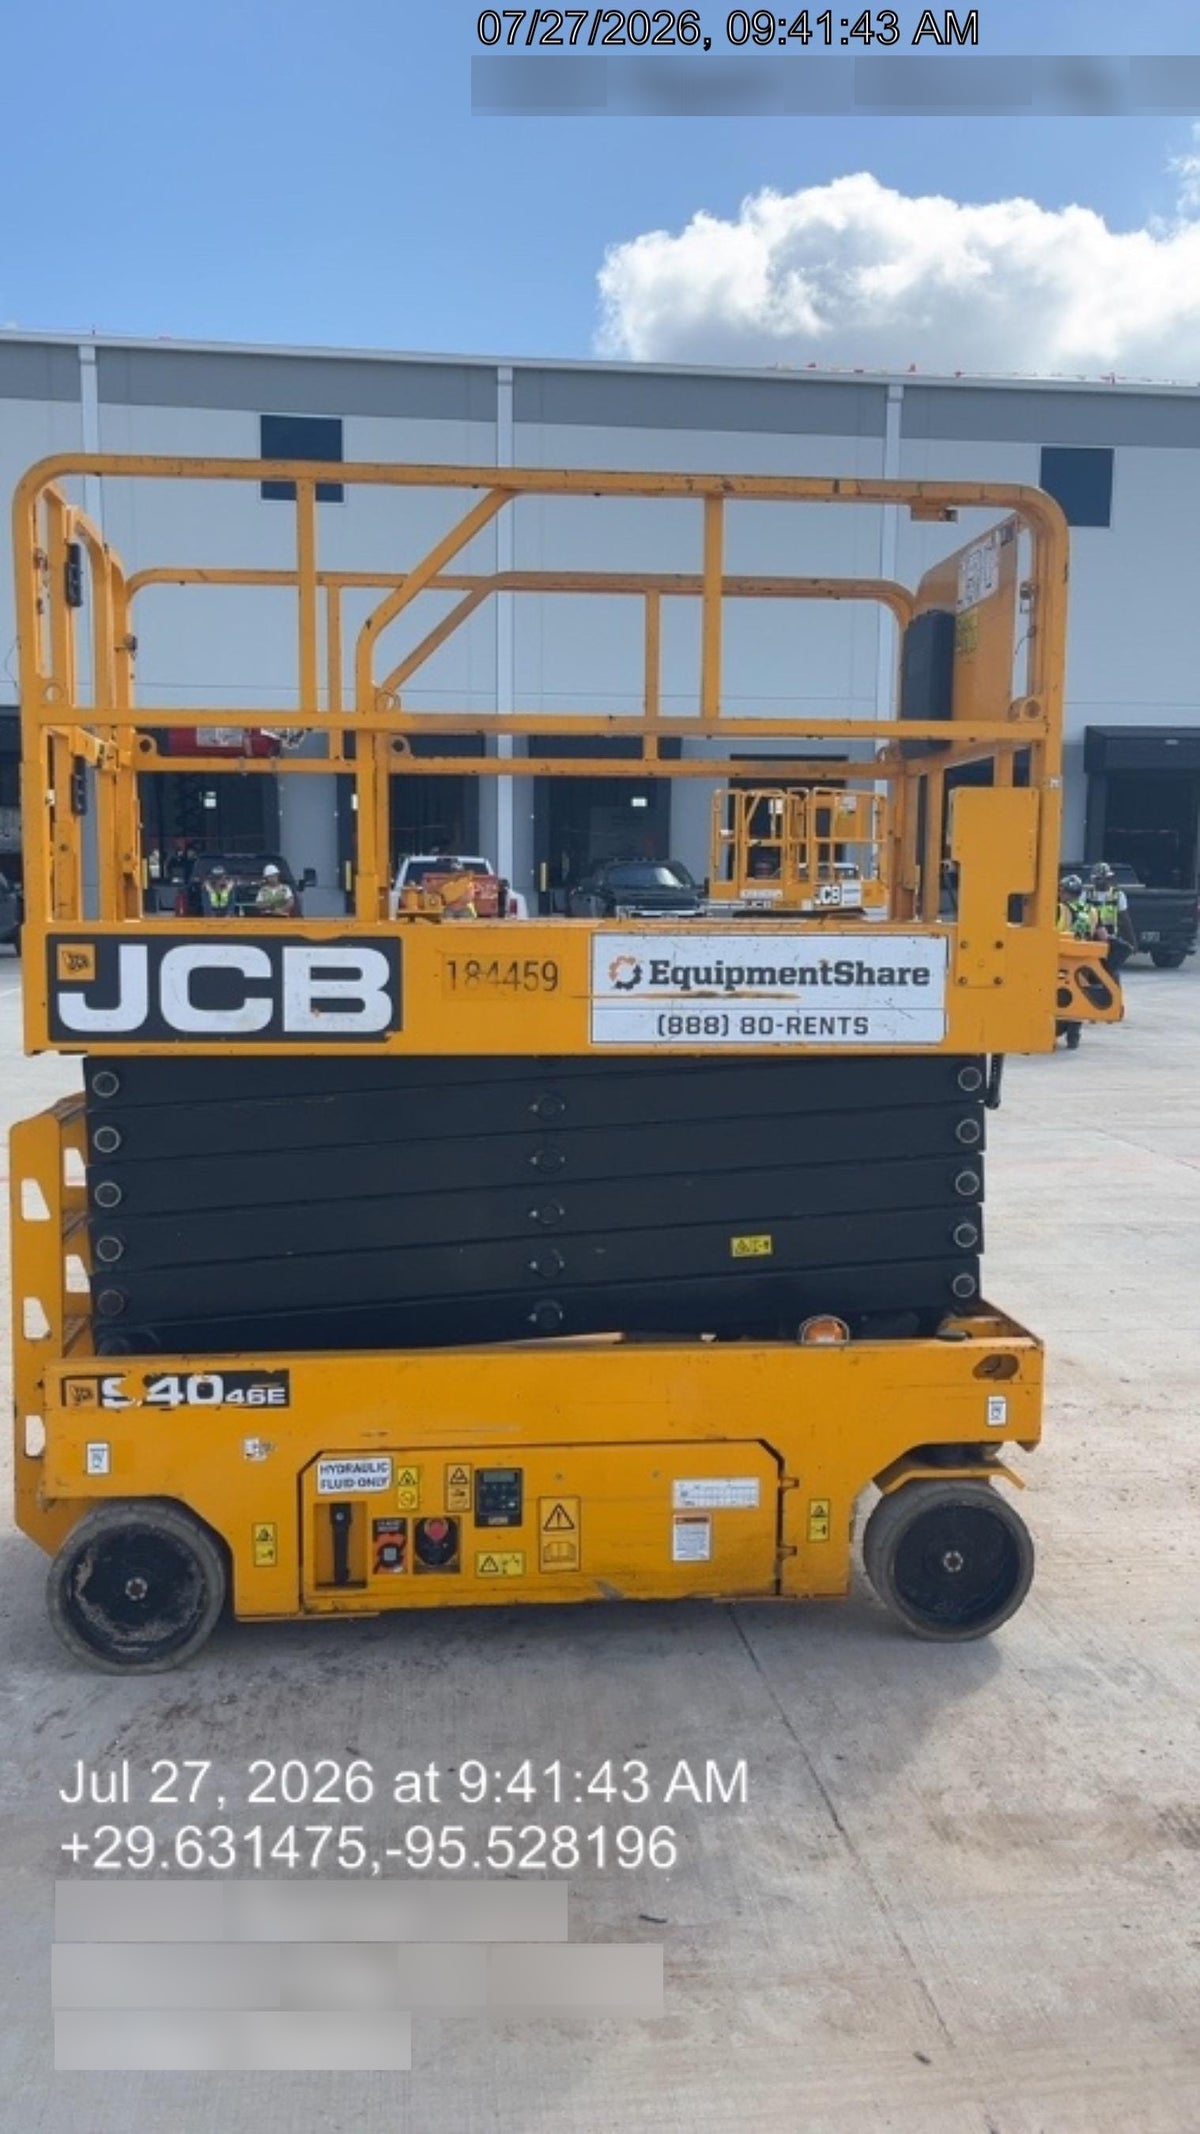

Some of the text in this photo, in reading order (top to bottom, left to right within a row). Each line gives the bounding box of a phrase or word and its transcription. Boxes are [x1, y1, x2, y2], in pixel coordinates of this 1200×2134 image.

[57, 943, 393, 1033] JCB
[446, 959, 560, 994] 184459
[648, 957, 931, 992] EquipmentShare
[657, 1015, 870, 1038] (888) 80-RENTS
[319, 1462, 389, 1475] HYDRAULIC
[320, 1476, 389, 1490] FLUID ONLY
